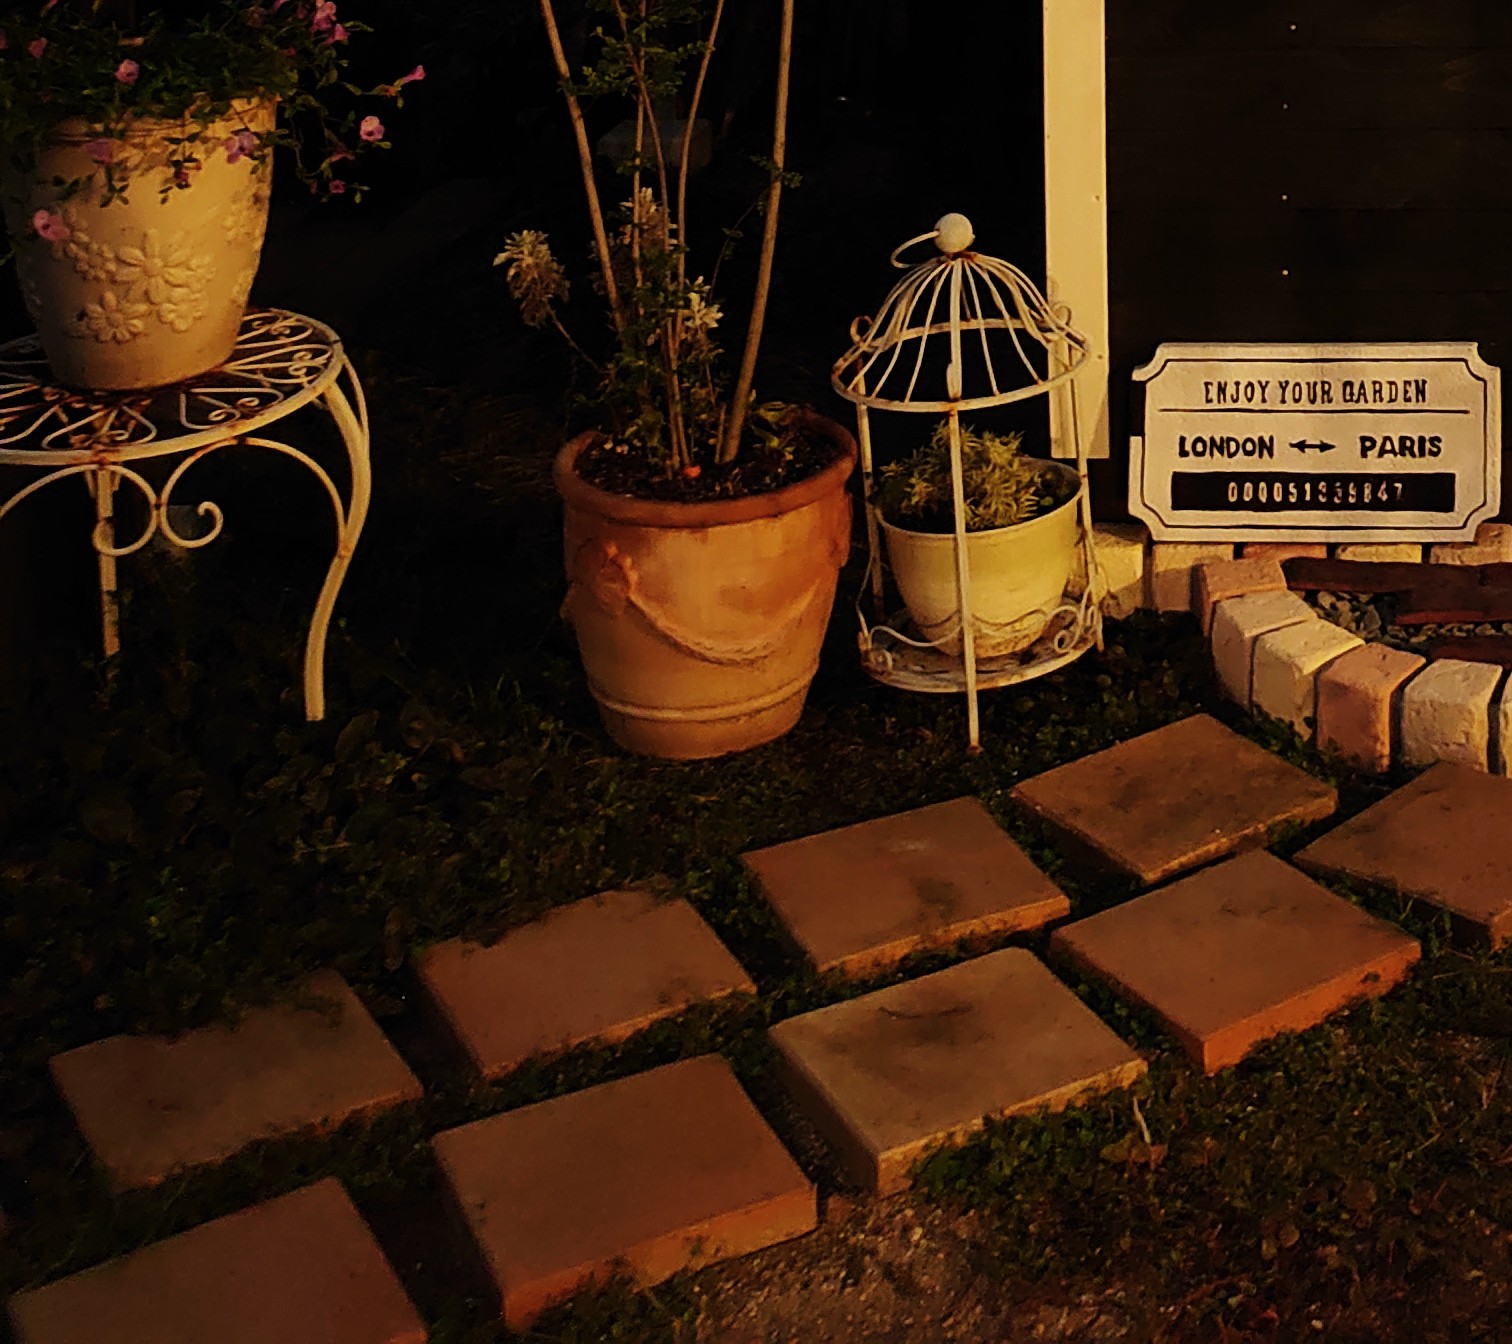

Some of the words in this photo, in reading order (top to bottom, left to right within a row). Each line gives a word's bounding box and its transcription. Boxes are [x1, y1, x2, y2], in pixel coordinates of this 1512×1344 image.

[1203, 379, 1271, 405] ENJOY
[1278, 379, 1334, 405] YOUR
[1341, 378, 1428, 405] GARDEN
[1178, 435, 1275, 459] LONDON
[1358, 434, 1443, 459] PARIS
